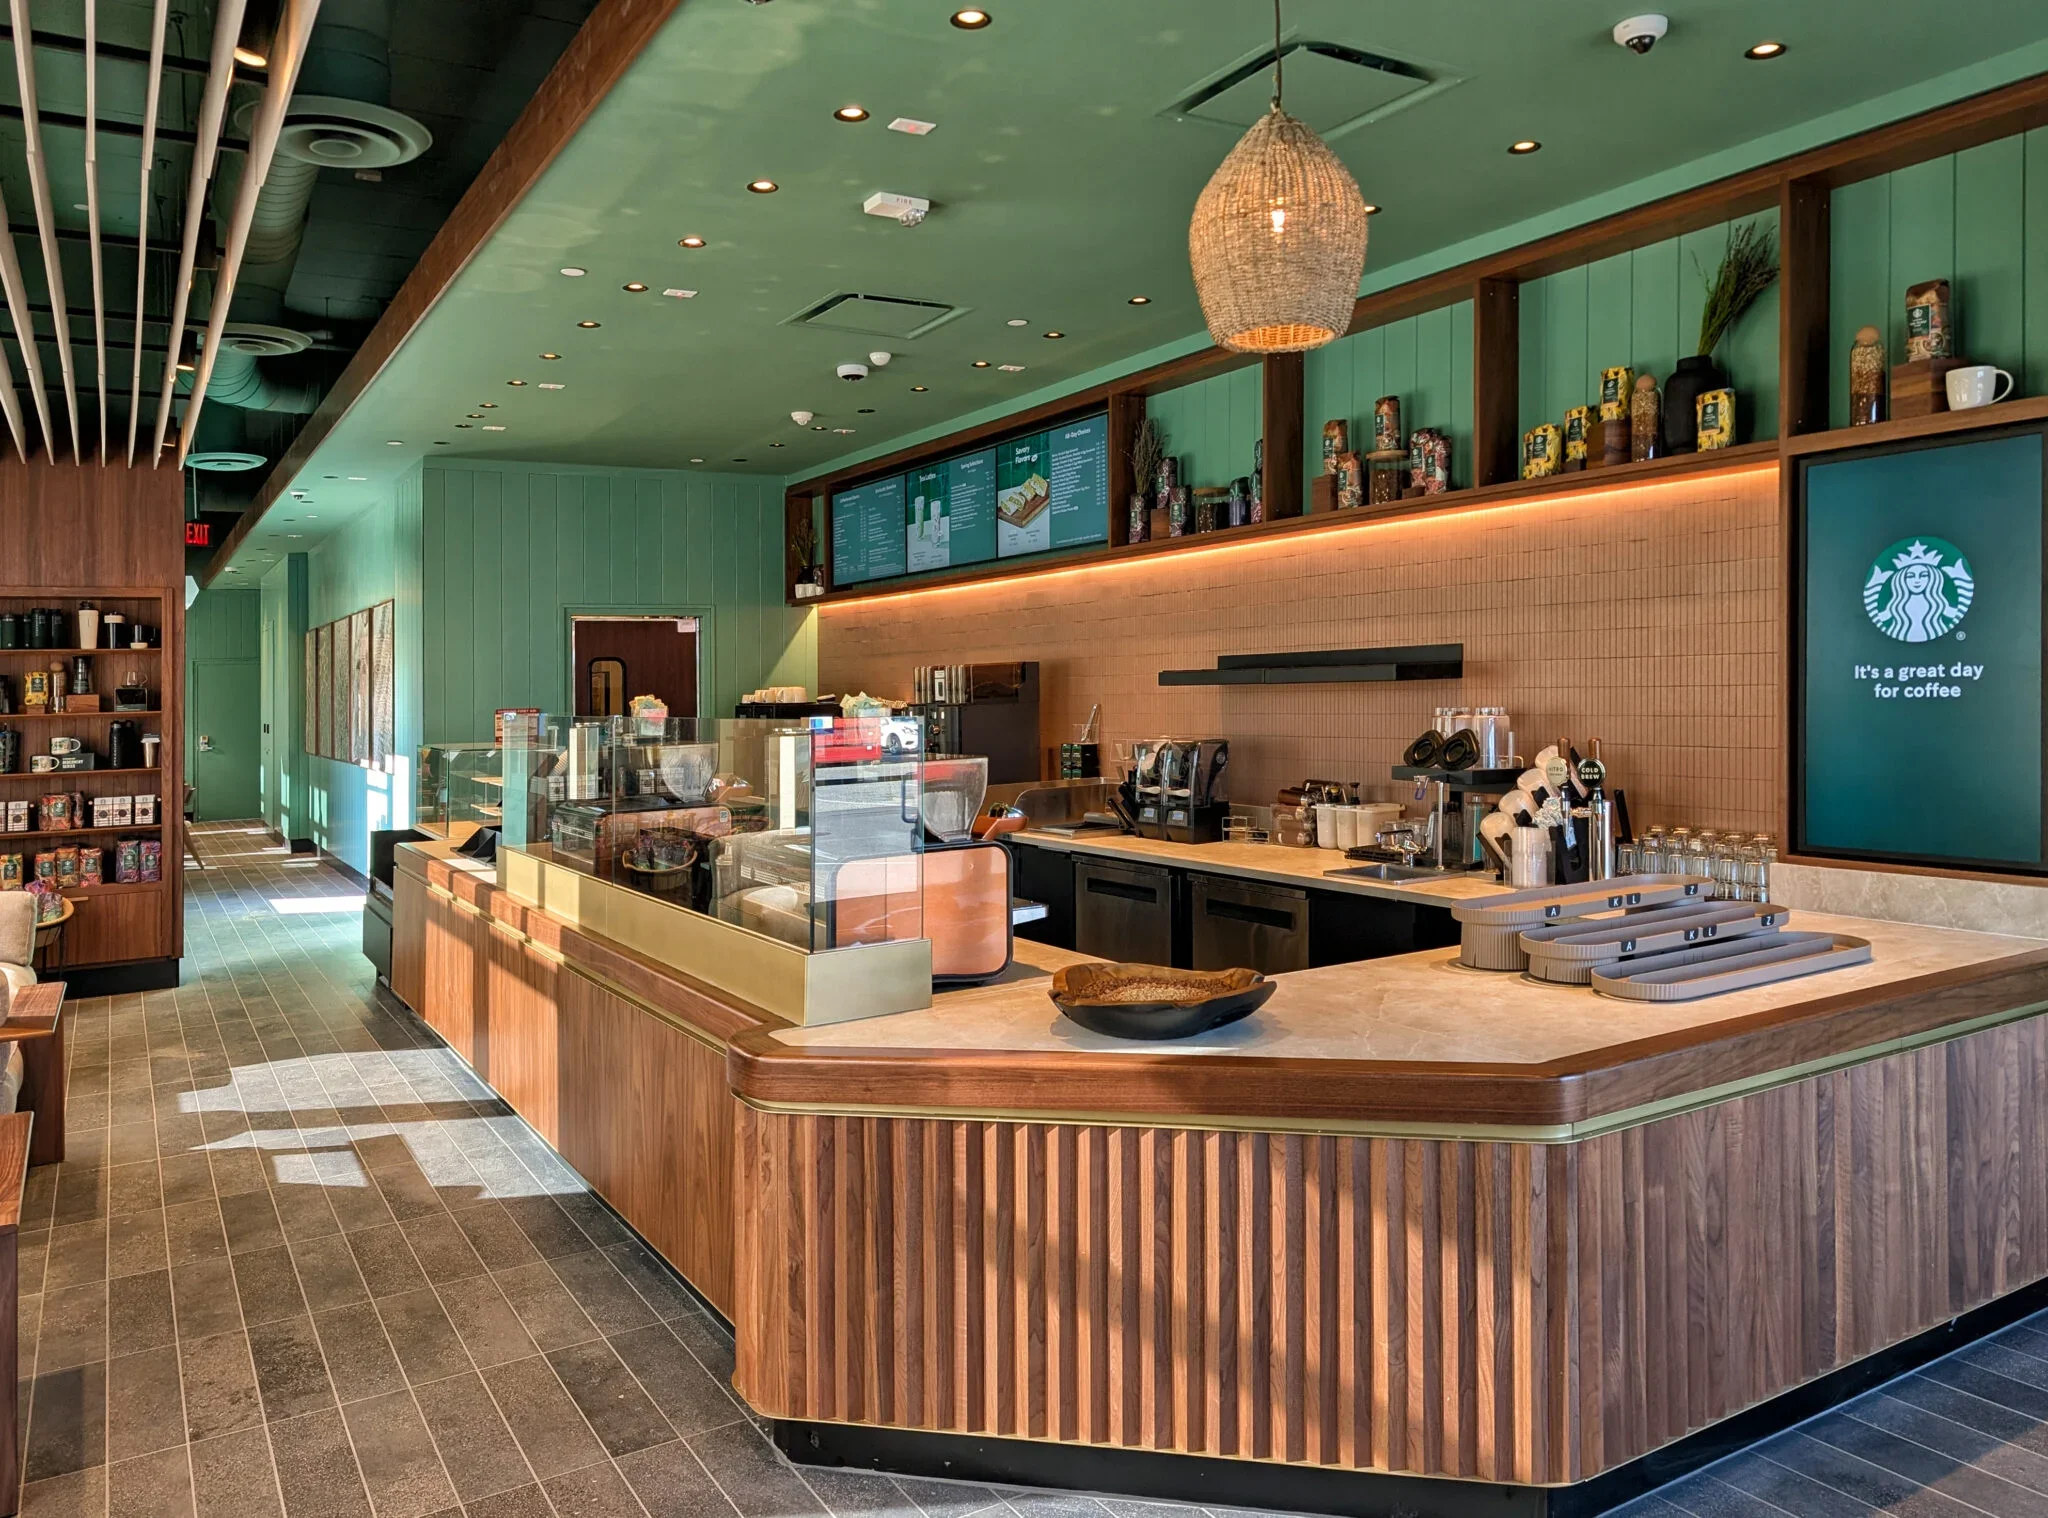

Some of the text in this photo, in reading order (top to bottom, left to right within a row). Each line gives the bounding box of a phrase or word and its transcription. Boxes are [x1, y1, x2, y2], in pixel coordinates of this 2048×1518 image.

[896, 197, 912, 205] FIRE
[1015, 446, 1031, 455] Savory
[185, 522, 210, 545] EXIT
[1854, 661, 1984, 682] It's a great day
[1873, 682, 1962, 698] for coffee
[1550, 907, 1557, 917] A
[1613, 898, 1619, 907] K
[1689, 885, 1695, 895] Z
[1626, 941, 1633, 951] A
[1689, 930, 1695, 940] K
[1766, 916, 1772, 926] Z
